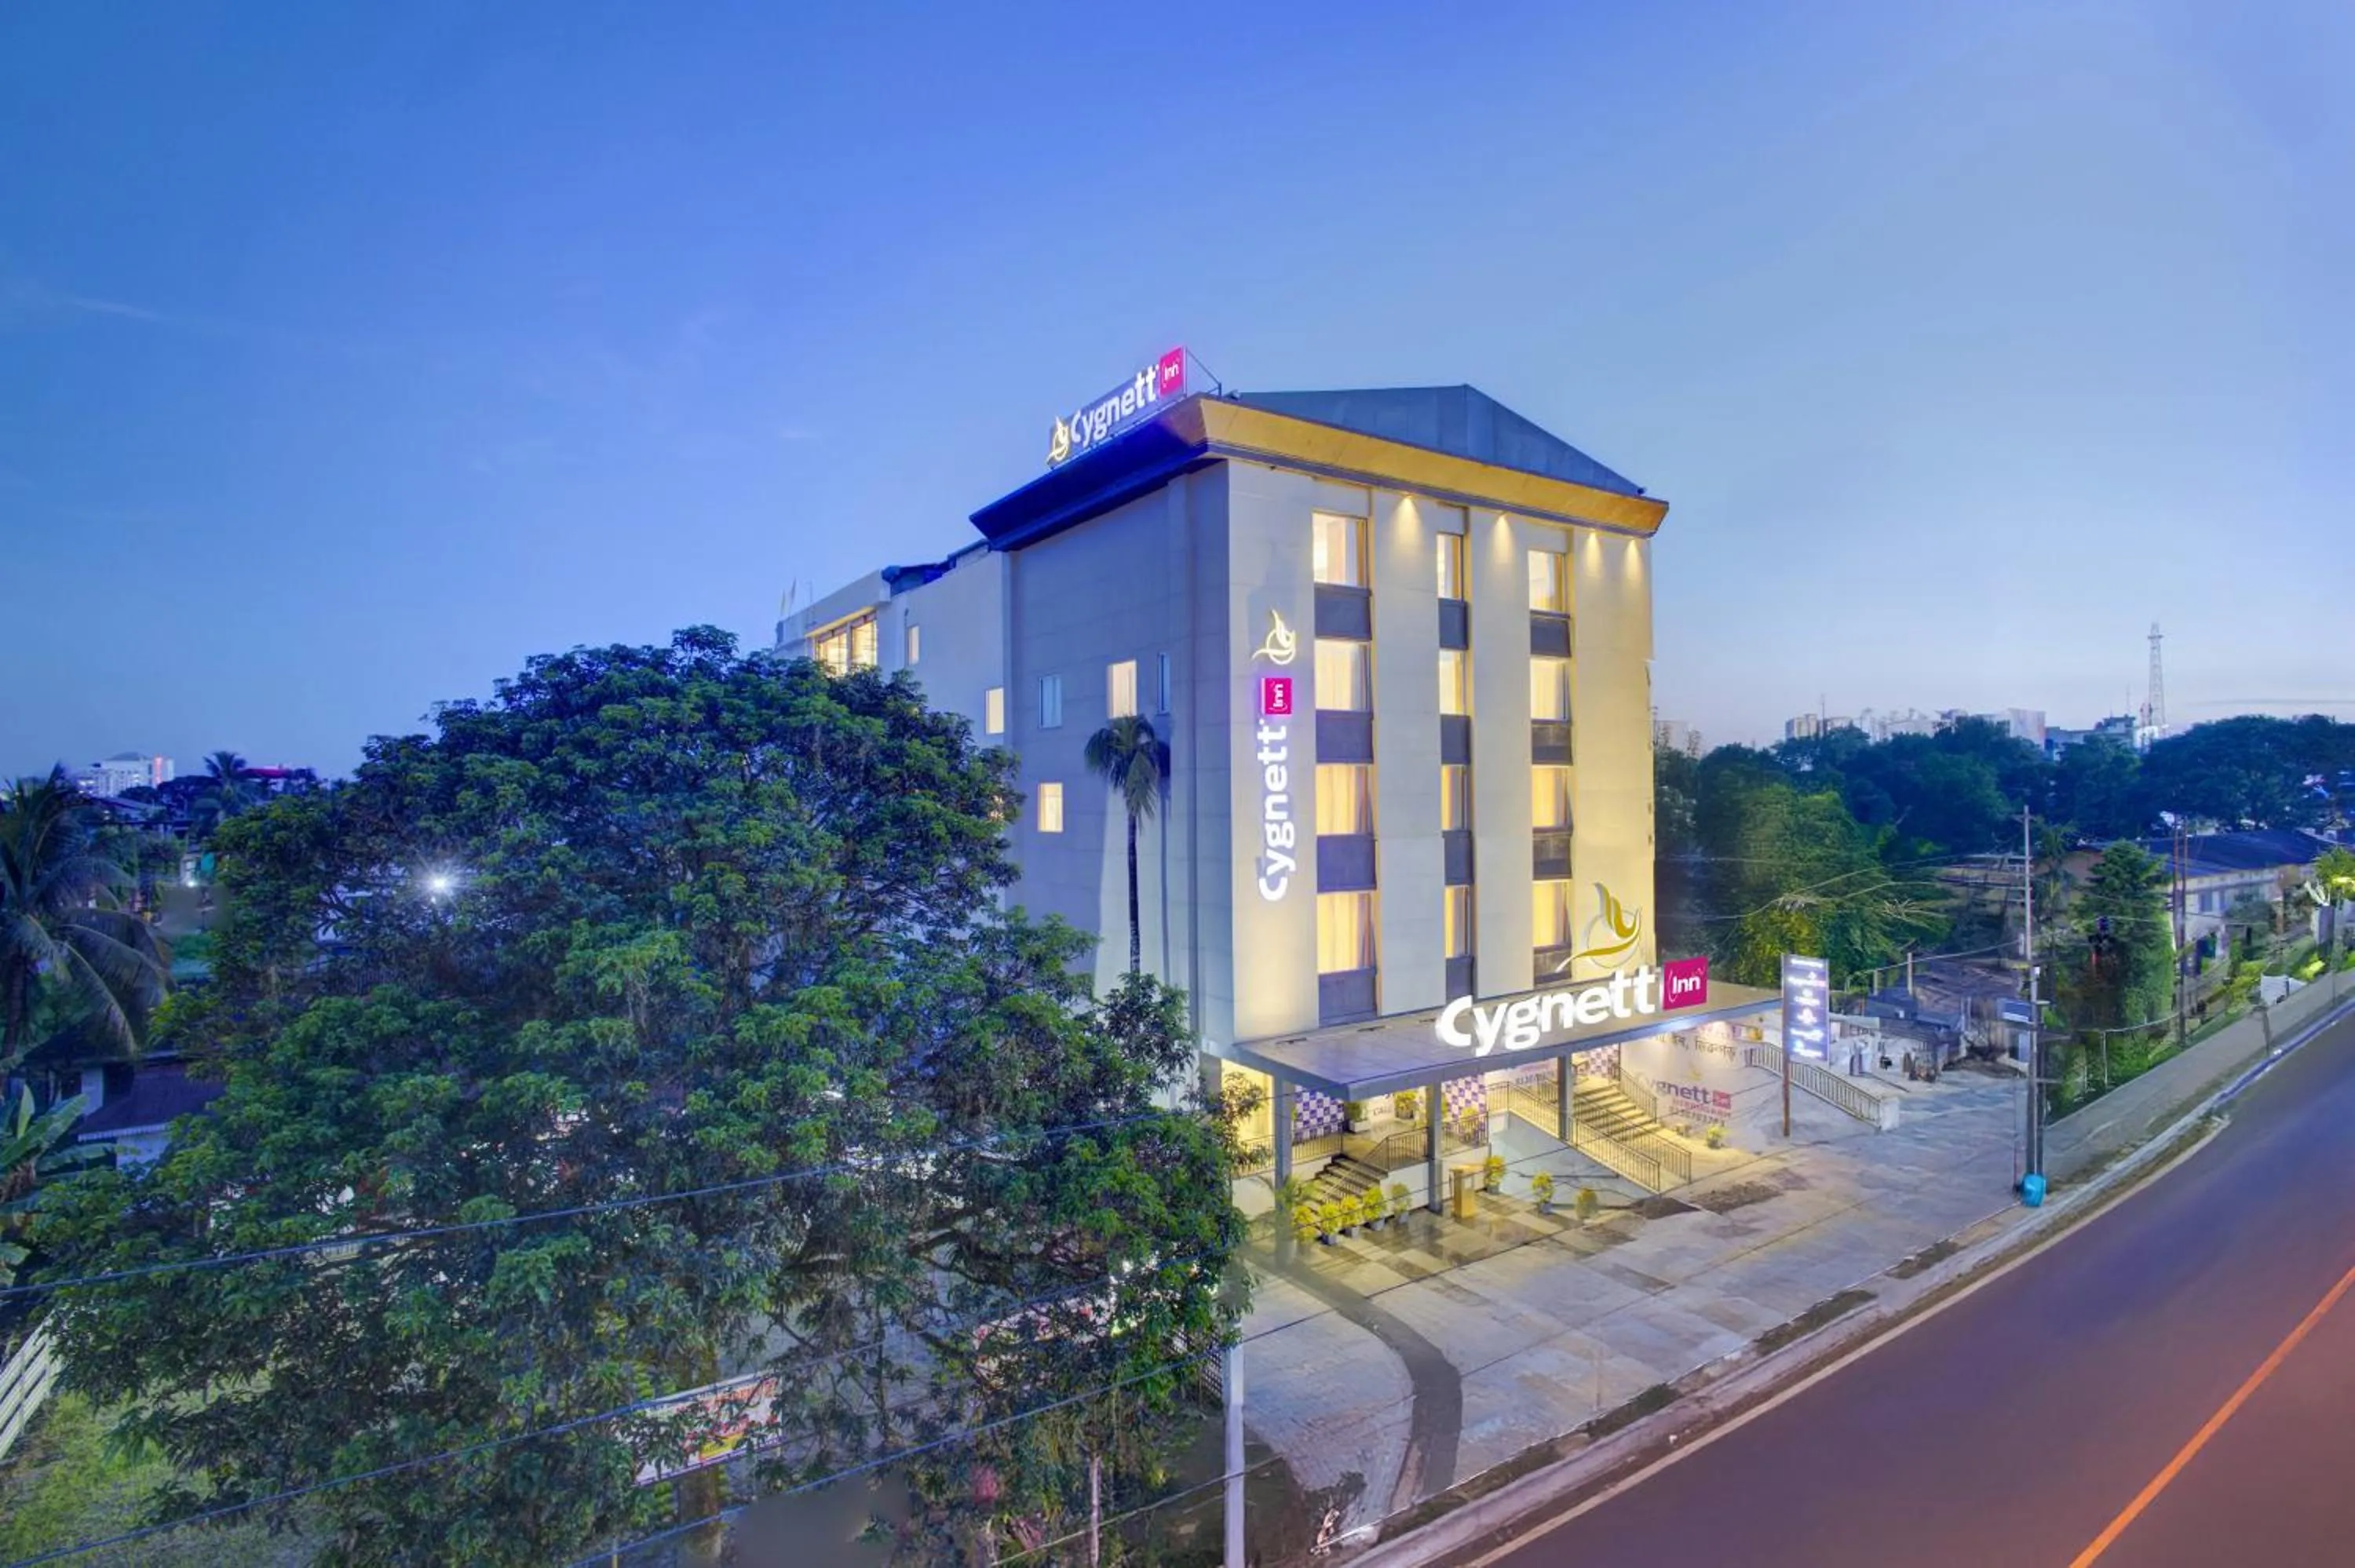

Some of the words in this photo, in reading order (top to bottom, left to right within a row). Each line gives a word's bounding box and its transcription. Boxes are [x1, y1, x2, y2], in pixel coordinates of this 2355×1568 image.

[1070, 366, 1157, 447] Cygnett
[1272, 683, 1283, 708] Inn
[1258, 725, 1296, 902] Cygnett
[1436, 965, 1656, 1057] Cygnett
[1672, 975, 1701, 995] Inn
[1636, 1074, 1710, 1104] ygnett
